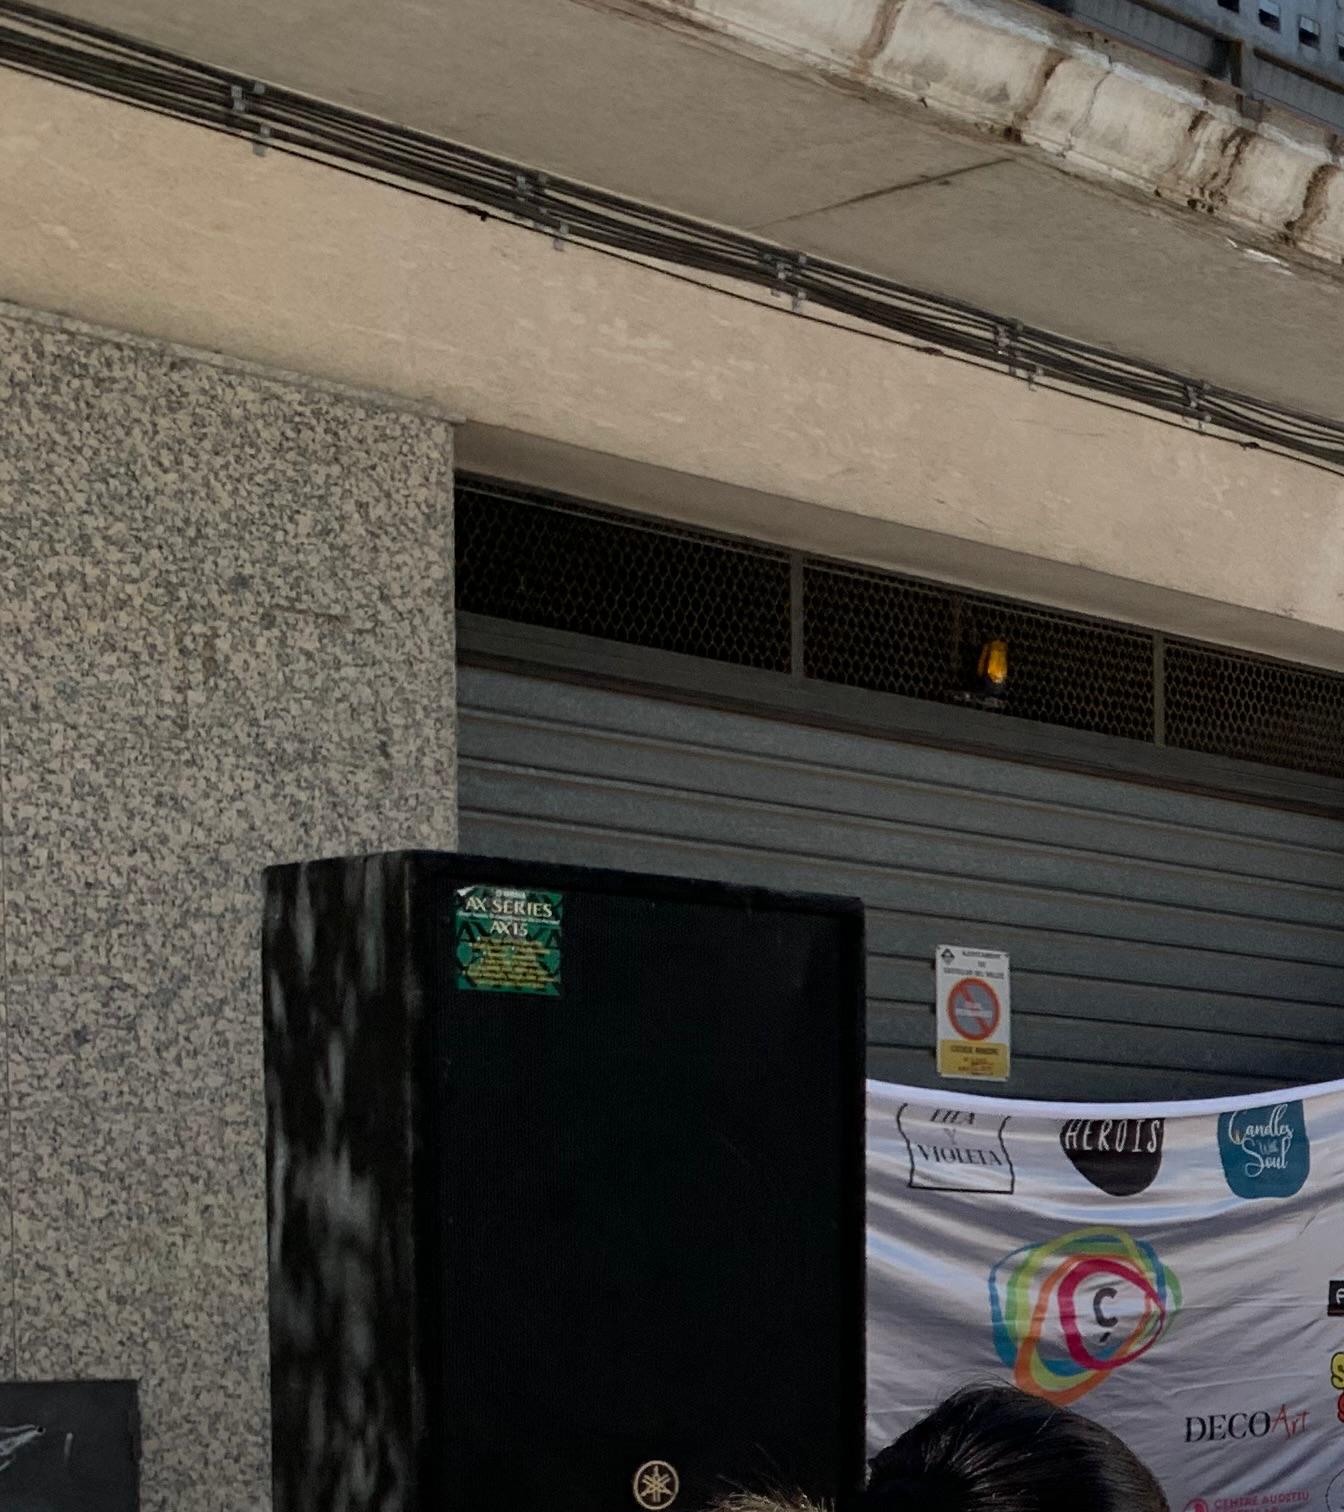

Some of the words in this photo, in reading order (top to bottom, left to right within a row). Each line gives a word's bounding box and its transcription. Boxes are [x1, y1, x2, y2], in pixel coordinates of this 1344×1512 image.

[465, 896, 487, 912] AX
[492, 899, 553, 919] SERIES
[1064, 1118, 1161, 1153] HEROIS
[1228, 1103, 1294, 1145] Candles
[917, 1144, 1002, 1166] VIOLETA
[1241, 1138, 1288, 1177] Soul
